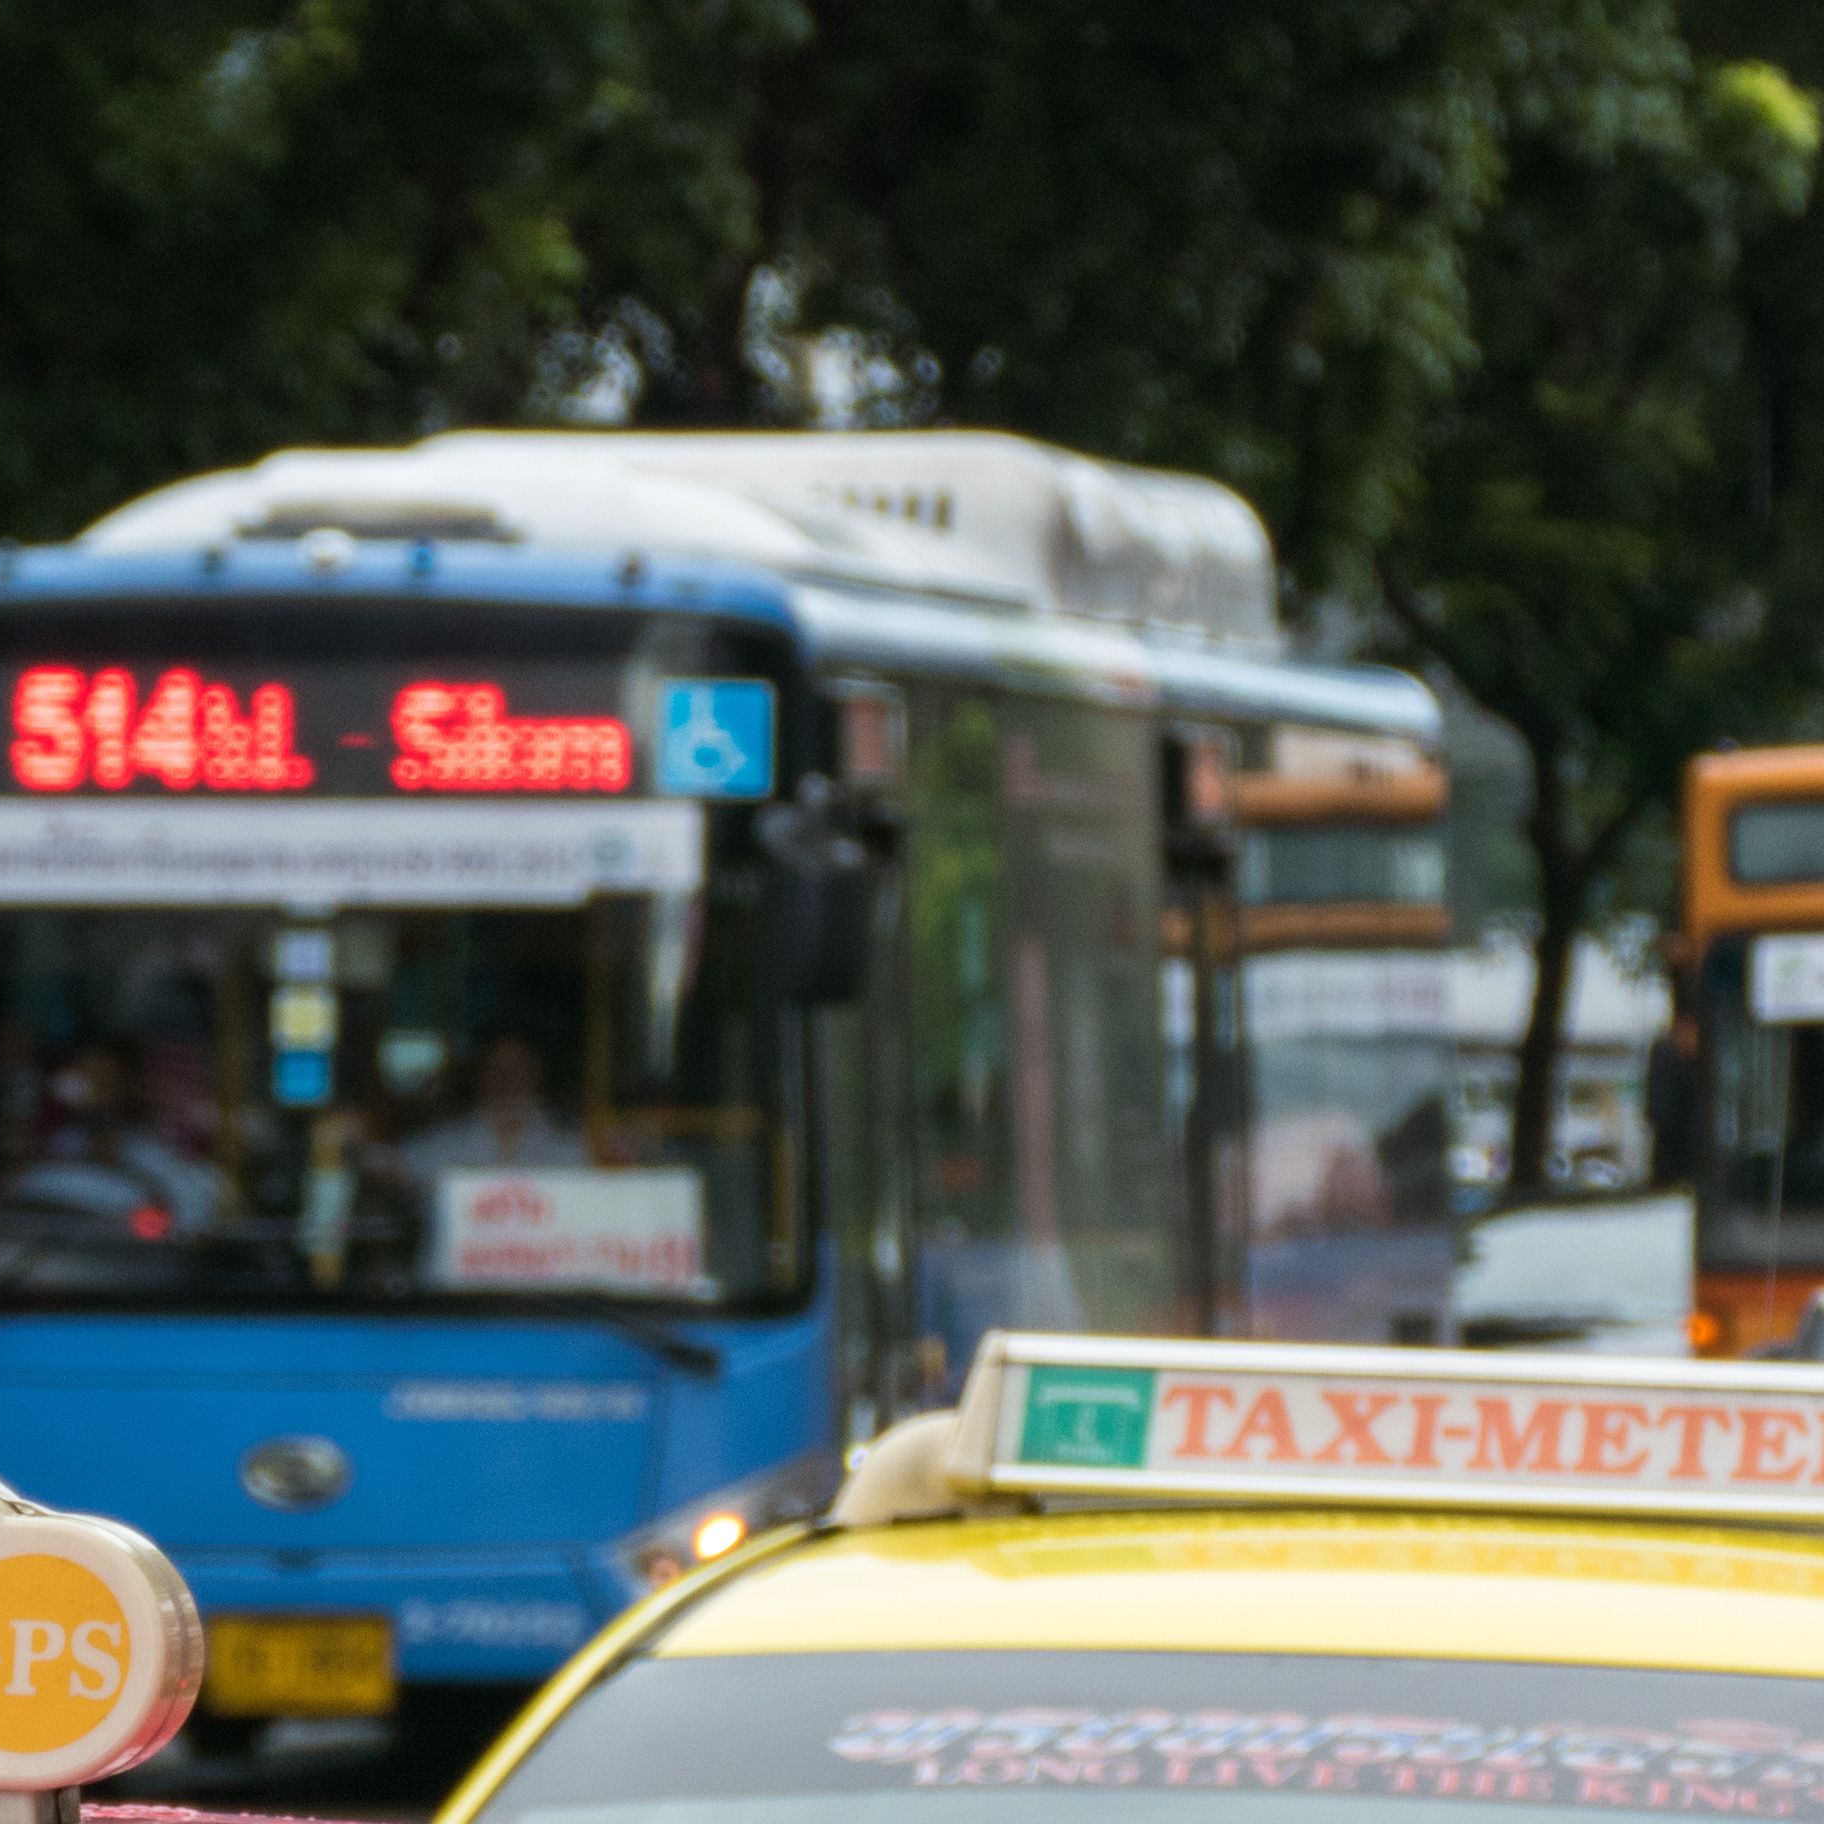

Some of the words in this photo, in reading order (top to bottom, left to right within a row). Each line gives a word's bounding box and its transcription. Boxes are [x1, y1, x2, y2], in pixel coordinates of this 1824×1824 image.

[915, 1753, 1149, 1788] LONG
[1168, 1754, 1372, 1792] LIVE
[1380, 1760, 1562, 1800] THE
[1578, 1765, 1796, 1818] KING
